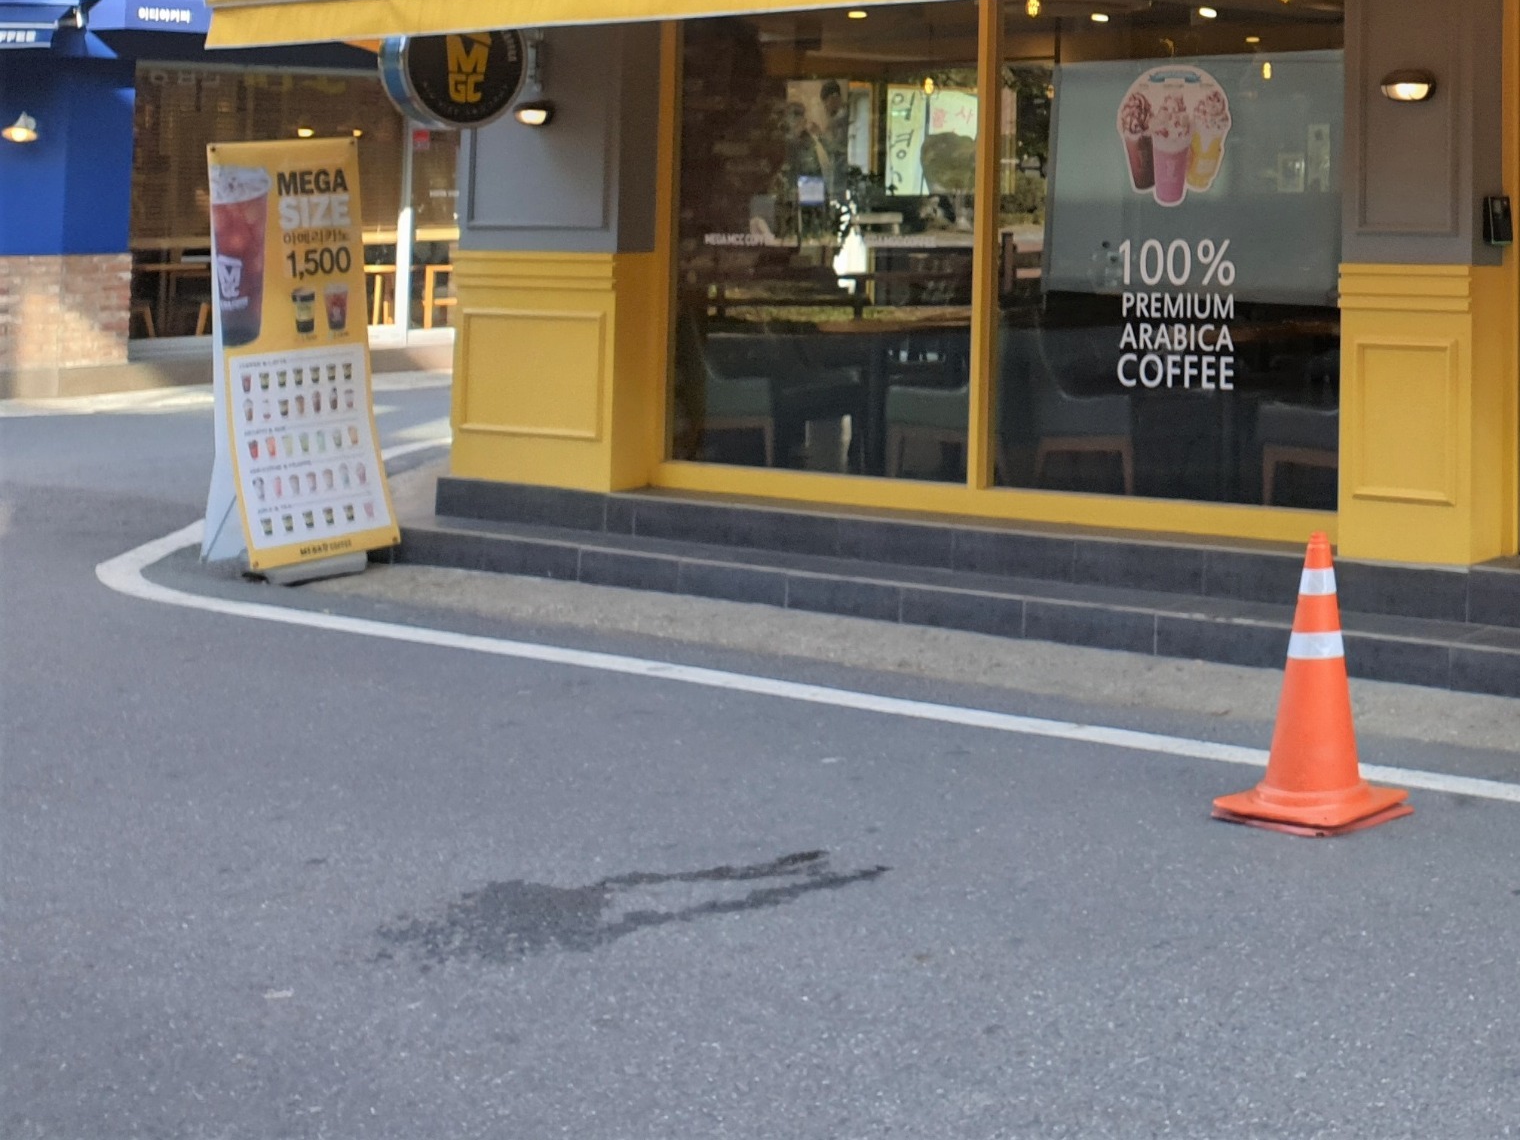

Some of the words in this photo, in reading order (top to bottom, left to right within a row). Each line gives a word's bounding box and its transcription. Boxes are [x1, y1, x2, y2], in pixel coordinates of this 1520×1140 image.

[277, 169, 348, 197] MEGA
[280, 195, 350, 230] SIZE
[287, 247, 351, 280] 1,500
[1119, 238, 1236, 287] 100%
[1121, 292, 1234, 320] PREMIUM
[1119, 323, 1234, 352] ARABICA
[1117, 354, 1234, 390] COFFEE
